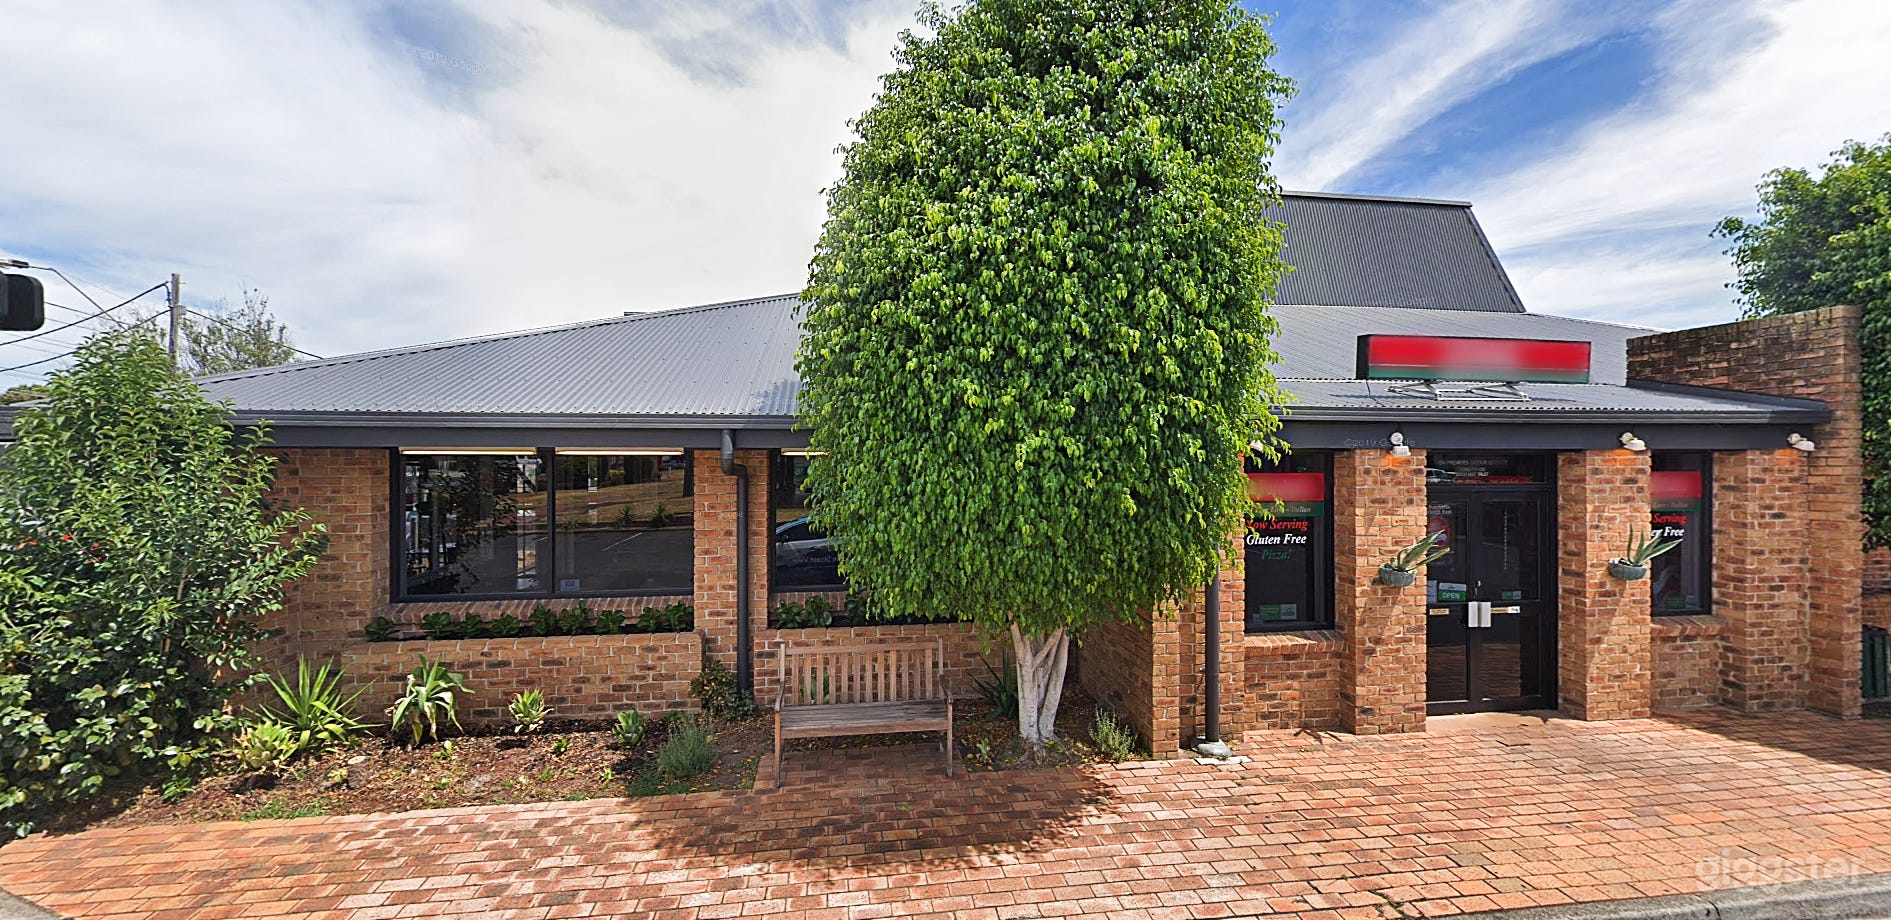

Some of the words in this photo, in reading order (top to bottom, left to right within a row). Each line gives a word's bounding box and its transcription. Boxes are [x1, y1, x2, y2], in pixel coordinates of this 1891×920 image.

[1269, 518, 1308, 532] Serving
[1653, 513, 1687, 525] Serving
[1663, 526, 1685, 537] Free
[1246, 533, 1281, 545] Gluten
[1283, 533, 1307, 544] Free
[1261, 548, 1292, 560] Pizza!
[1441, 592, 1460, 600] OPEN
